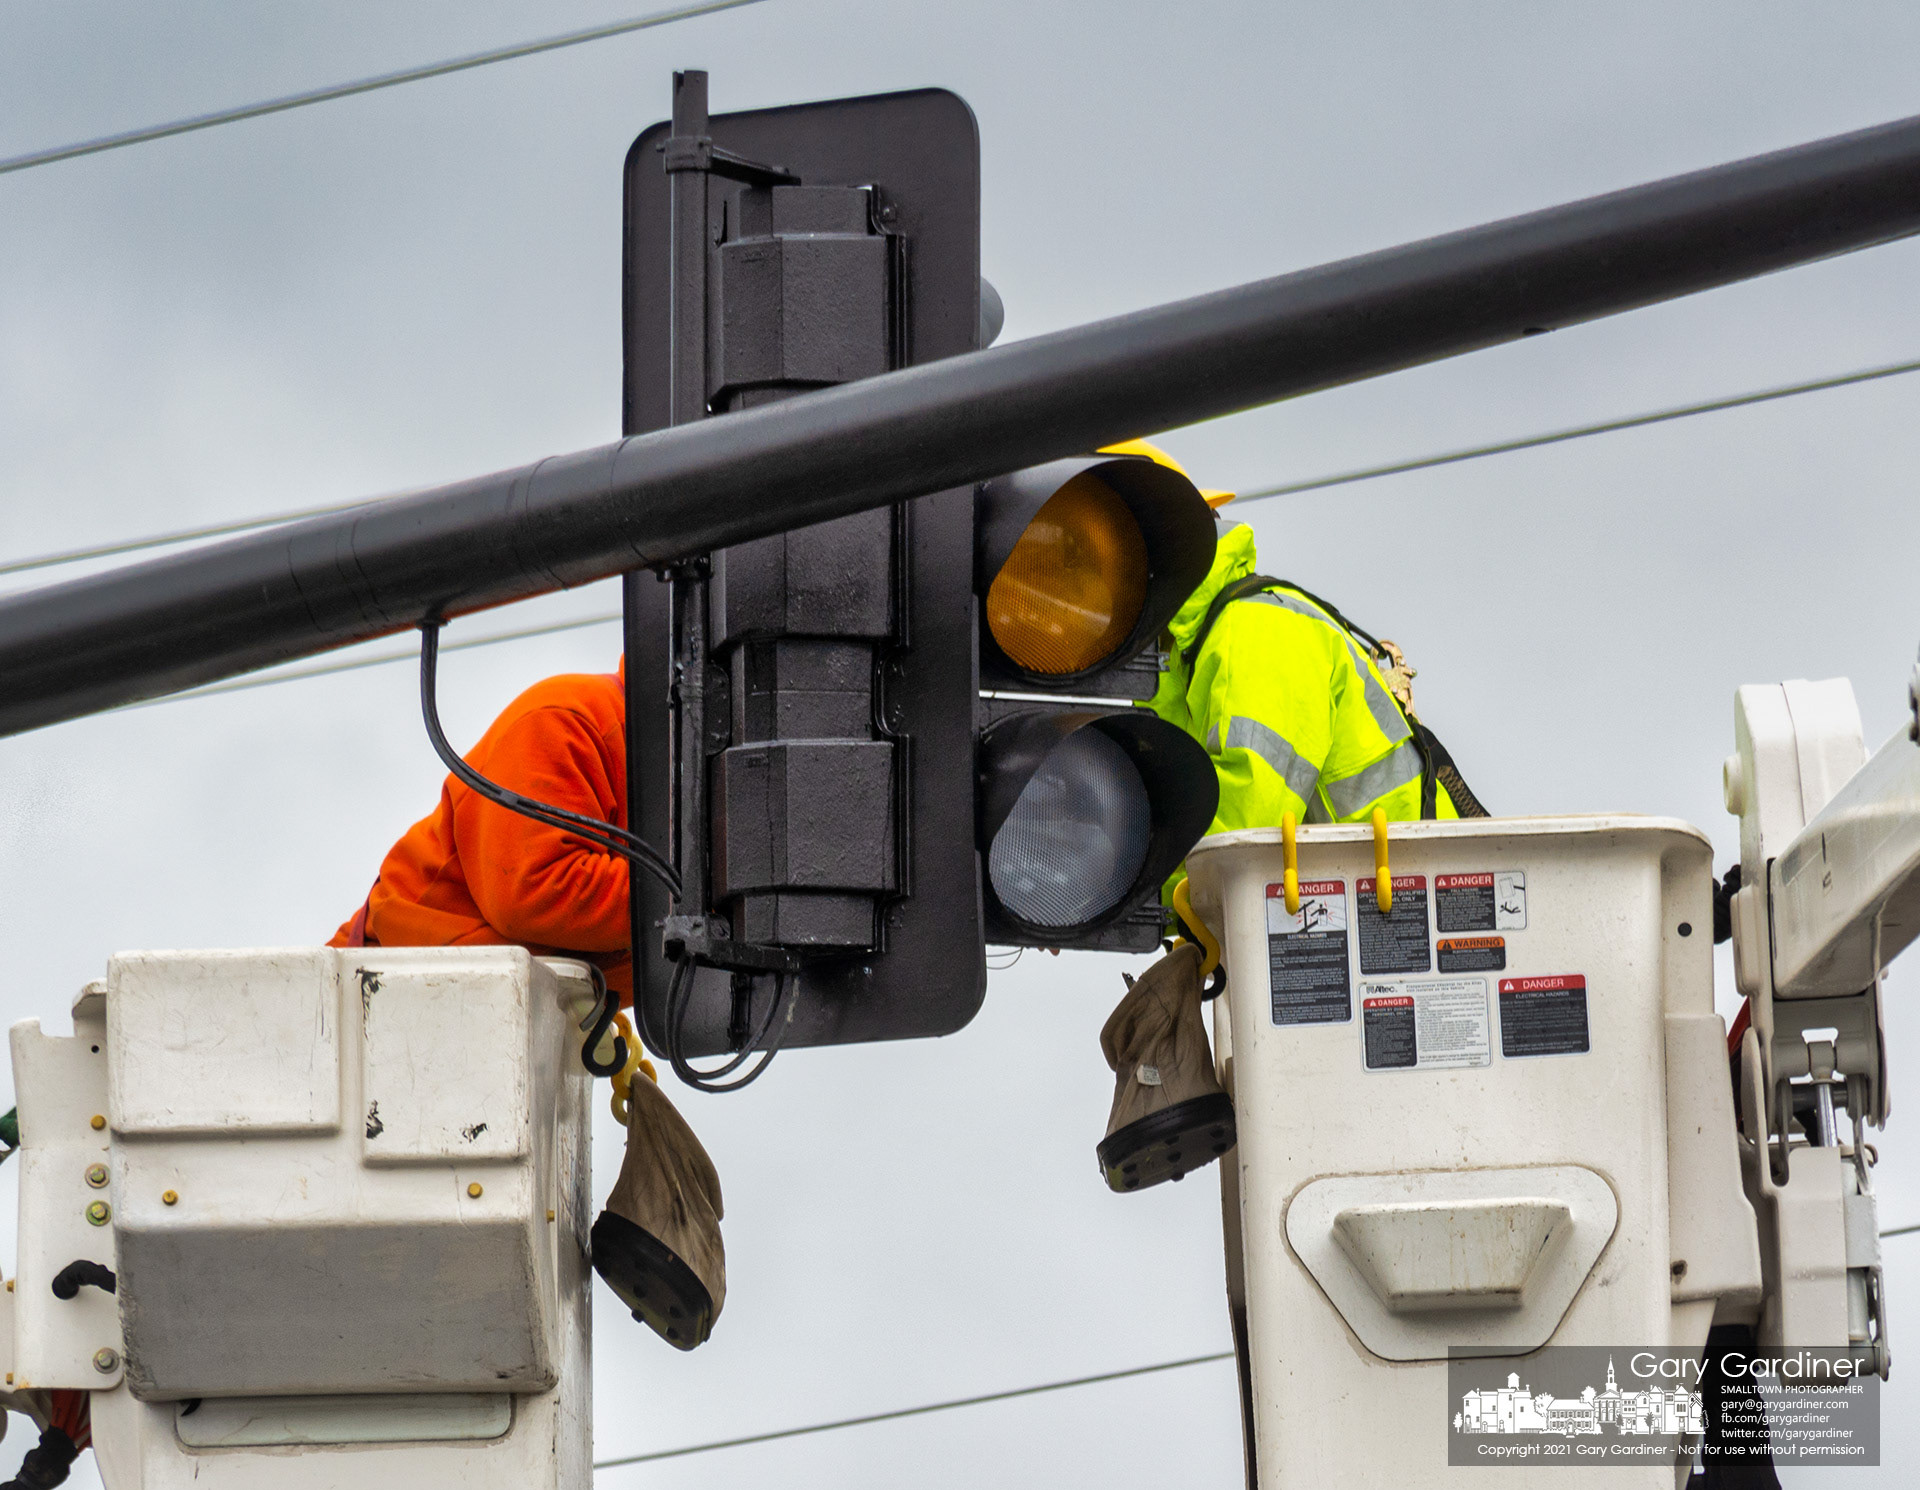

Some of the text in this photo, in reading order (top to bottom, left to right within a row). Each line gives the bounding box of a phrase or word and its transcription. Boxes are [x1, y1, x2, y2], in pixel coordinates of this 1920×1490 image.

[1391, 878, 1415, 887] NGER
[1450, 875, 1492, 886] DANGER
[1299, 883, 1335, 894] ANGER
[1397, 889, 1425, 897] QUALIFIED
[1454, 938, 1500, 948] WARNING
[1522, 978, 1564, 989] DANGER
[1377, 998, 1408, 1007] DANGER
